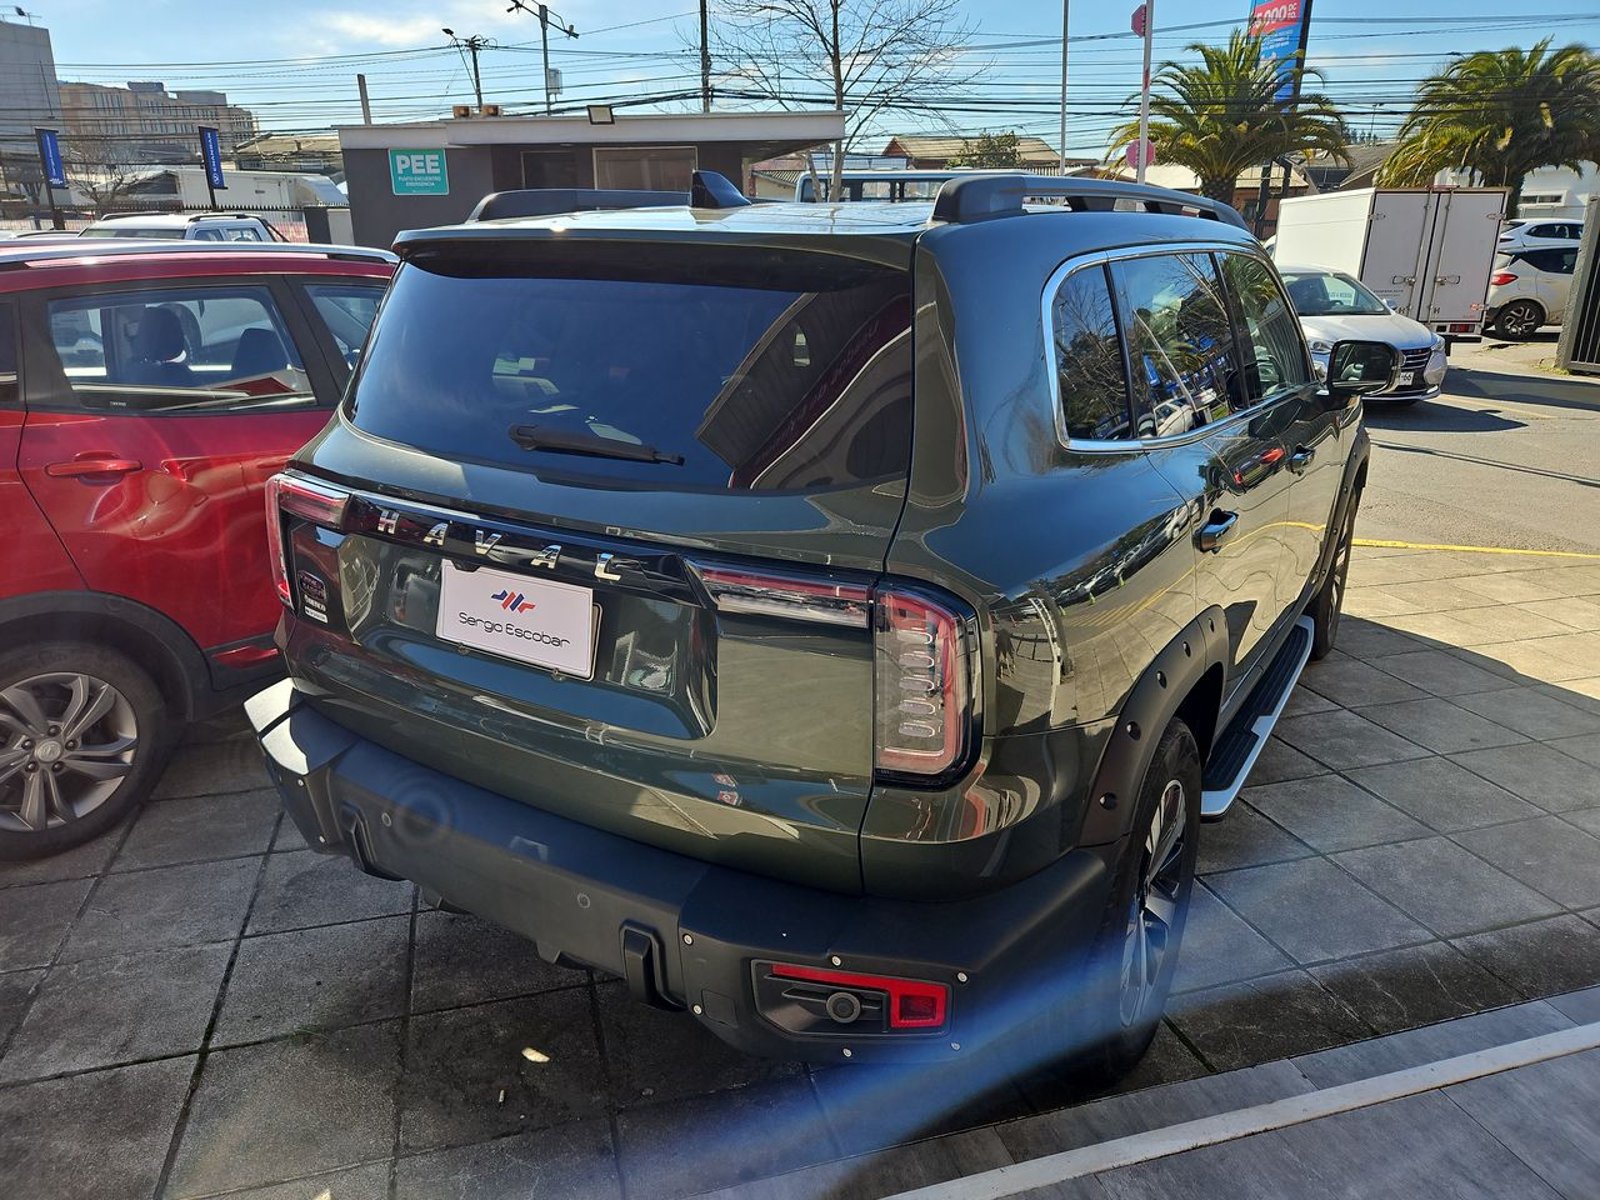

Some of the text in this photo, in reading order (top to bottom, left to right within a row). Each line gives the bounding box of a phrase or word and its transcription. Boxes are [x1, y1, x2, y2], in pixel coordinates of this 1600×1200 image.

[395, 154, 441, 175] PEE
[377, 509, 622, 582] HAVAL
[458, 611, 571, 649] Sergo Escobar
